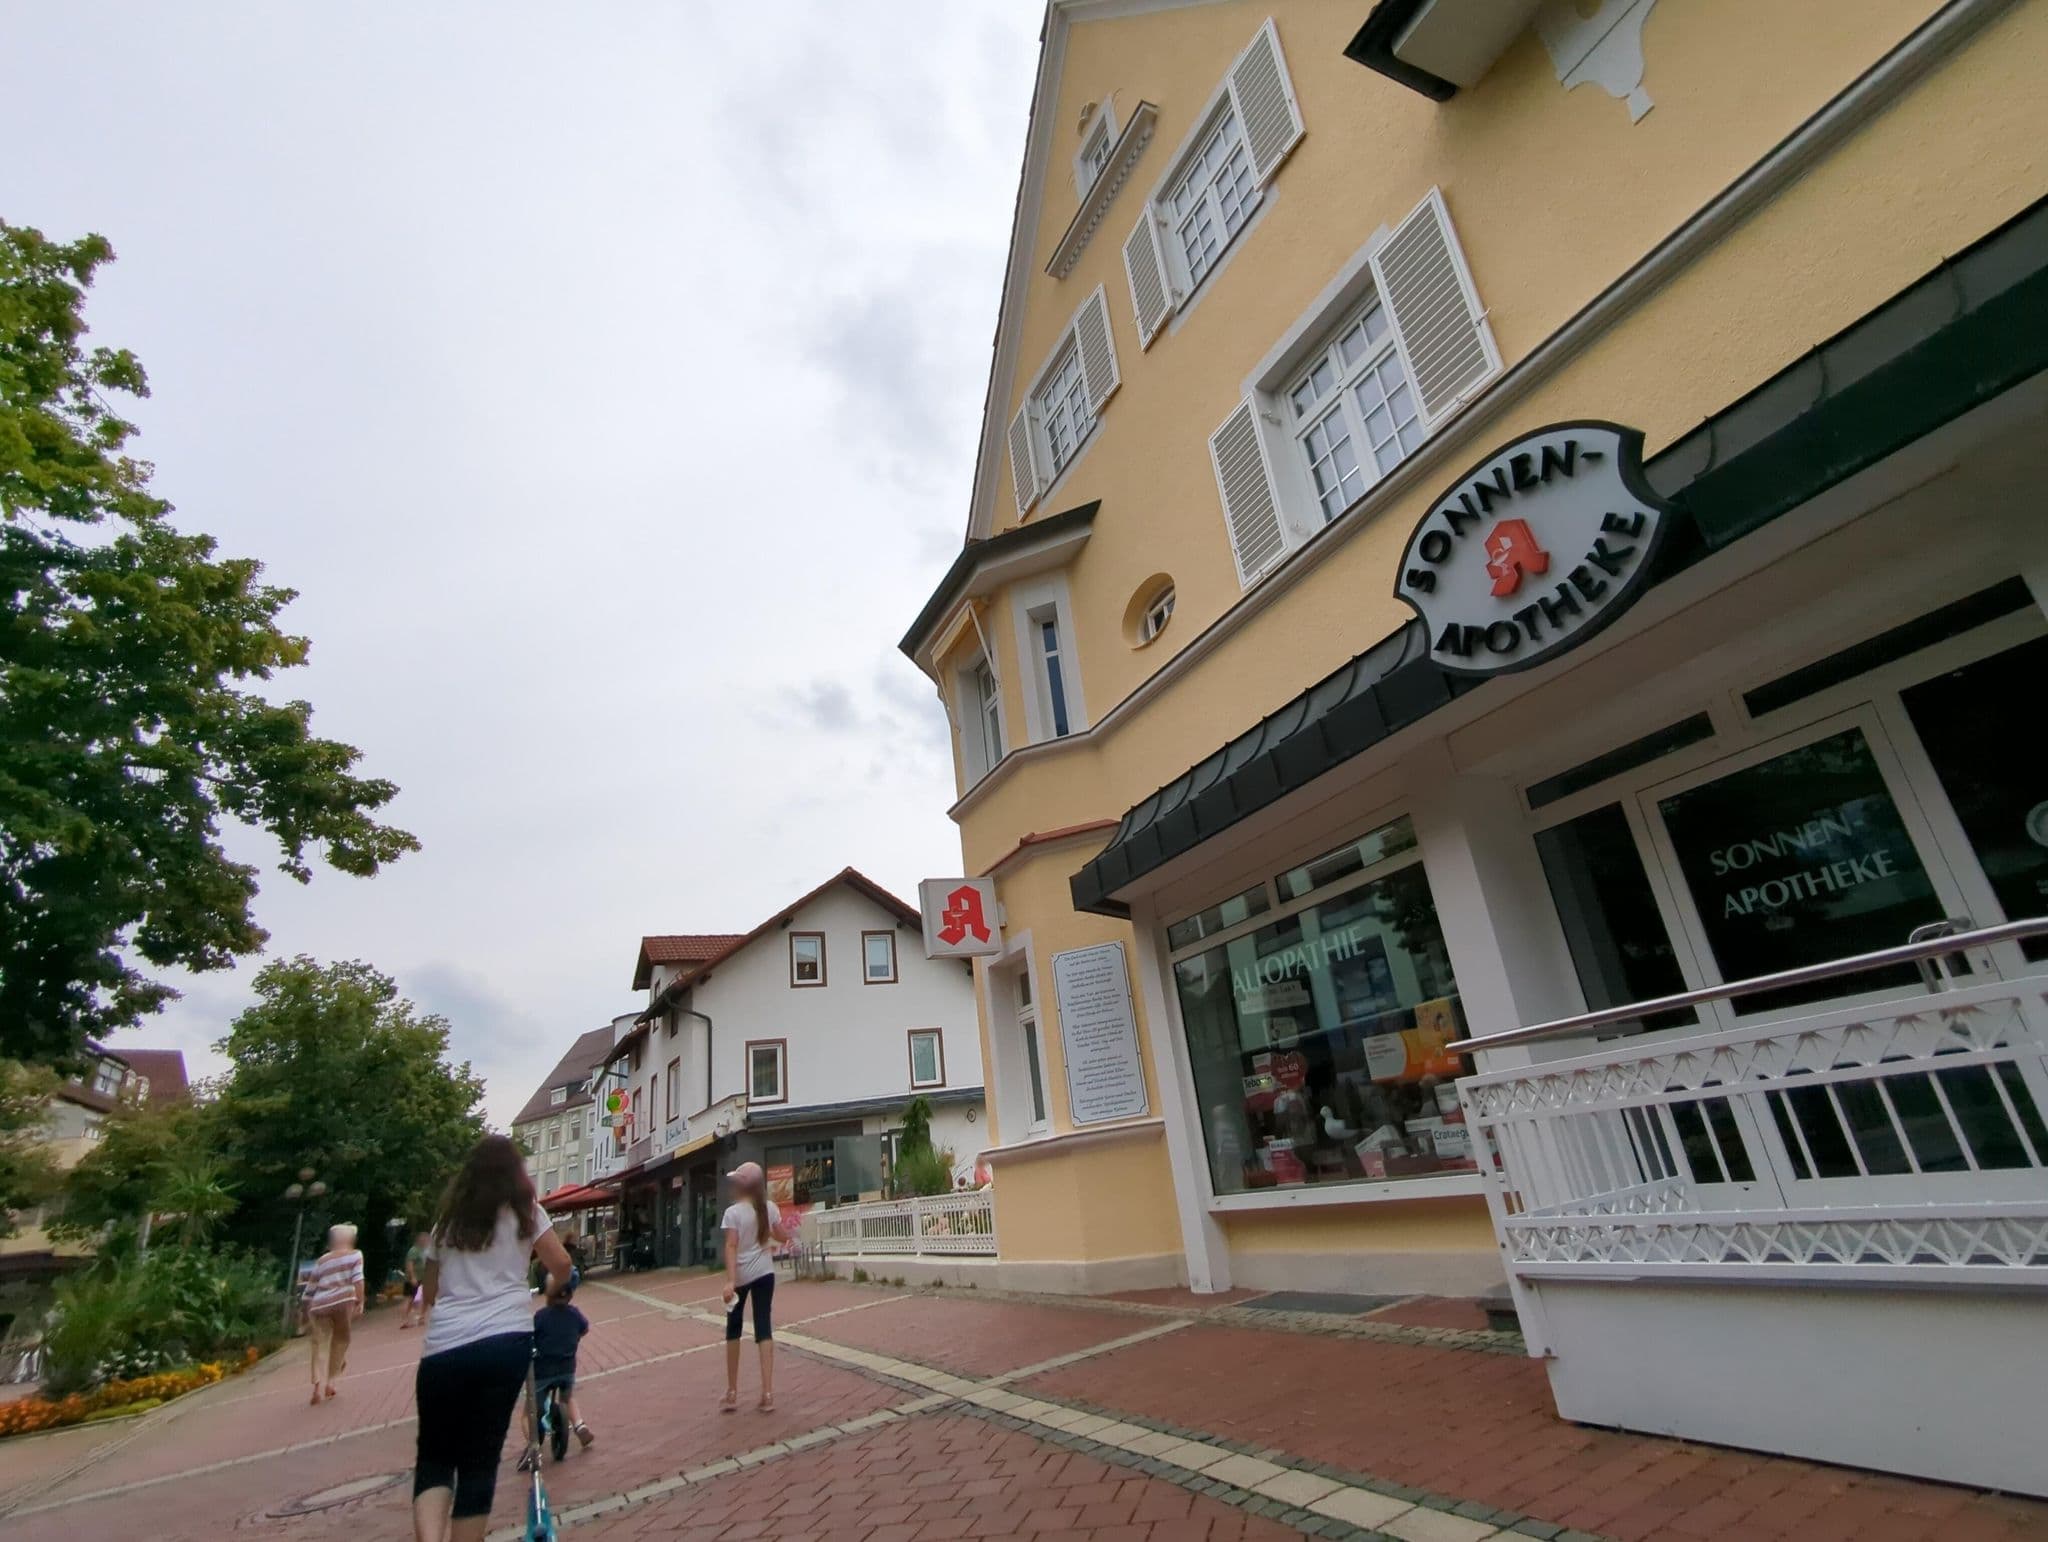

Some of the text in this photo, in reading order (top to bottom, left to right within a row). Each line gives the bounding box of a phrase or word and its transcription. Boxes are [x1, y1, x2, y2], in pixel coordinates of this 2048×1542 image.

[1406, 440, 1604, 593] SONNEN-
[1434, 511, 1645, 656] APOTHEKE
[1709, 806, 1864, 877] SONNEN-
[1723, 849, 1898, 919] APOTHEKE
[1231, 926, 1366, 996] ALLOPATHIE
[1244, 1074, 1273, 1088] Teboin
